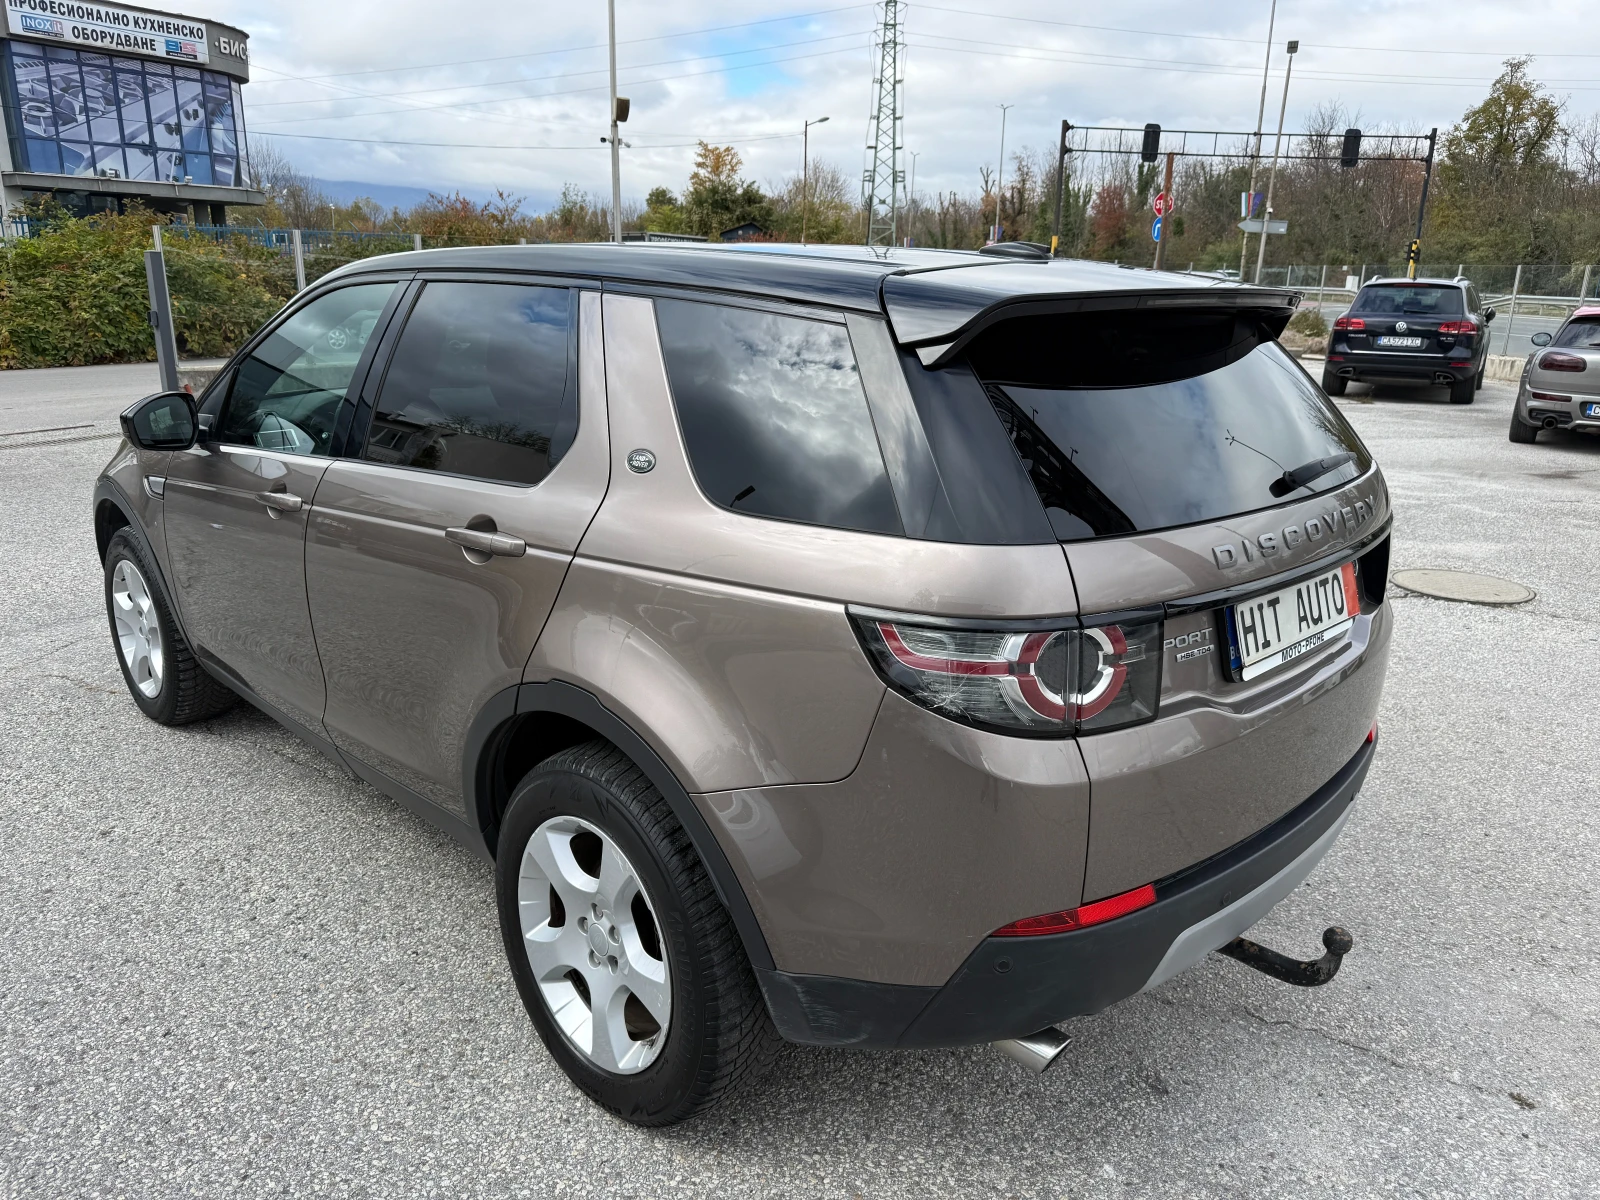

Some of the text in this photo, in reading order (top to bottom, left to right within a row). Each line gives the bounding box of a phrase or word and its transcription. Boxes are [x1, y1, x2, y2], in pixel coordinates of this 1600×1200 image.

[71, 25, 157, 52] ОБОРУДВАНЕ
[133, 15, 204, 40] КУХНЕНСКО
[1155, 199, 1172, 210] ST
[1212, 495, 1377, 570] DISCOVERY
[1240, 573, 1345, 657] HIT AUTO
[1164, 627, 1213, 652] PORT
[1281, 632, 1325, 662] MOTO-PFOHE
[1180, 646, 1212, 661] HSE TD4
